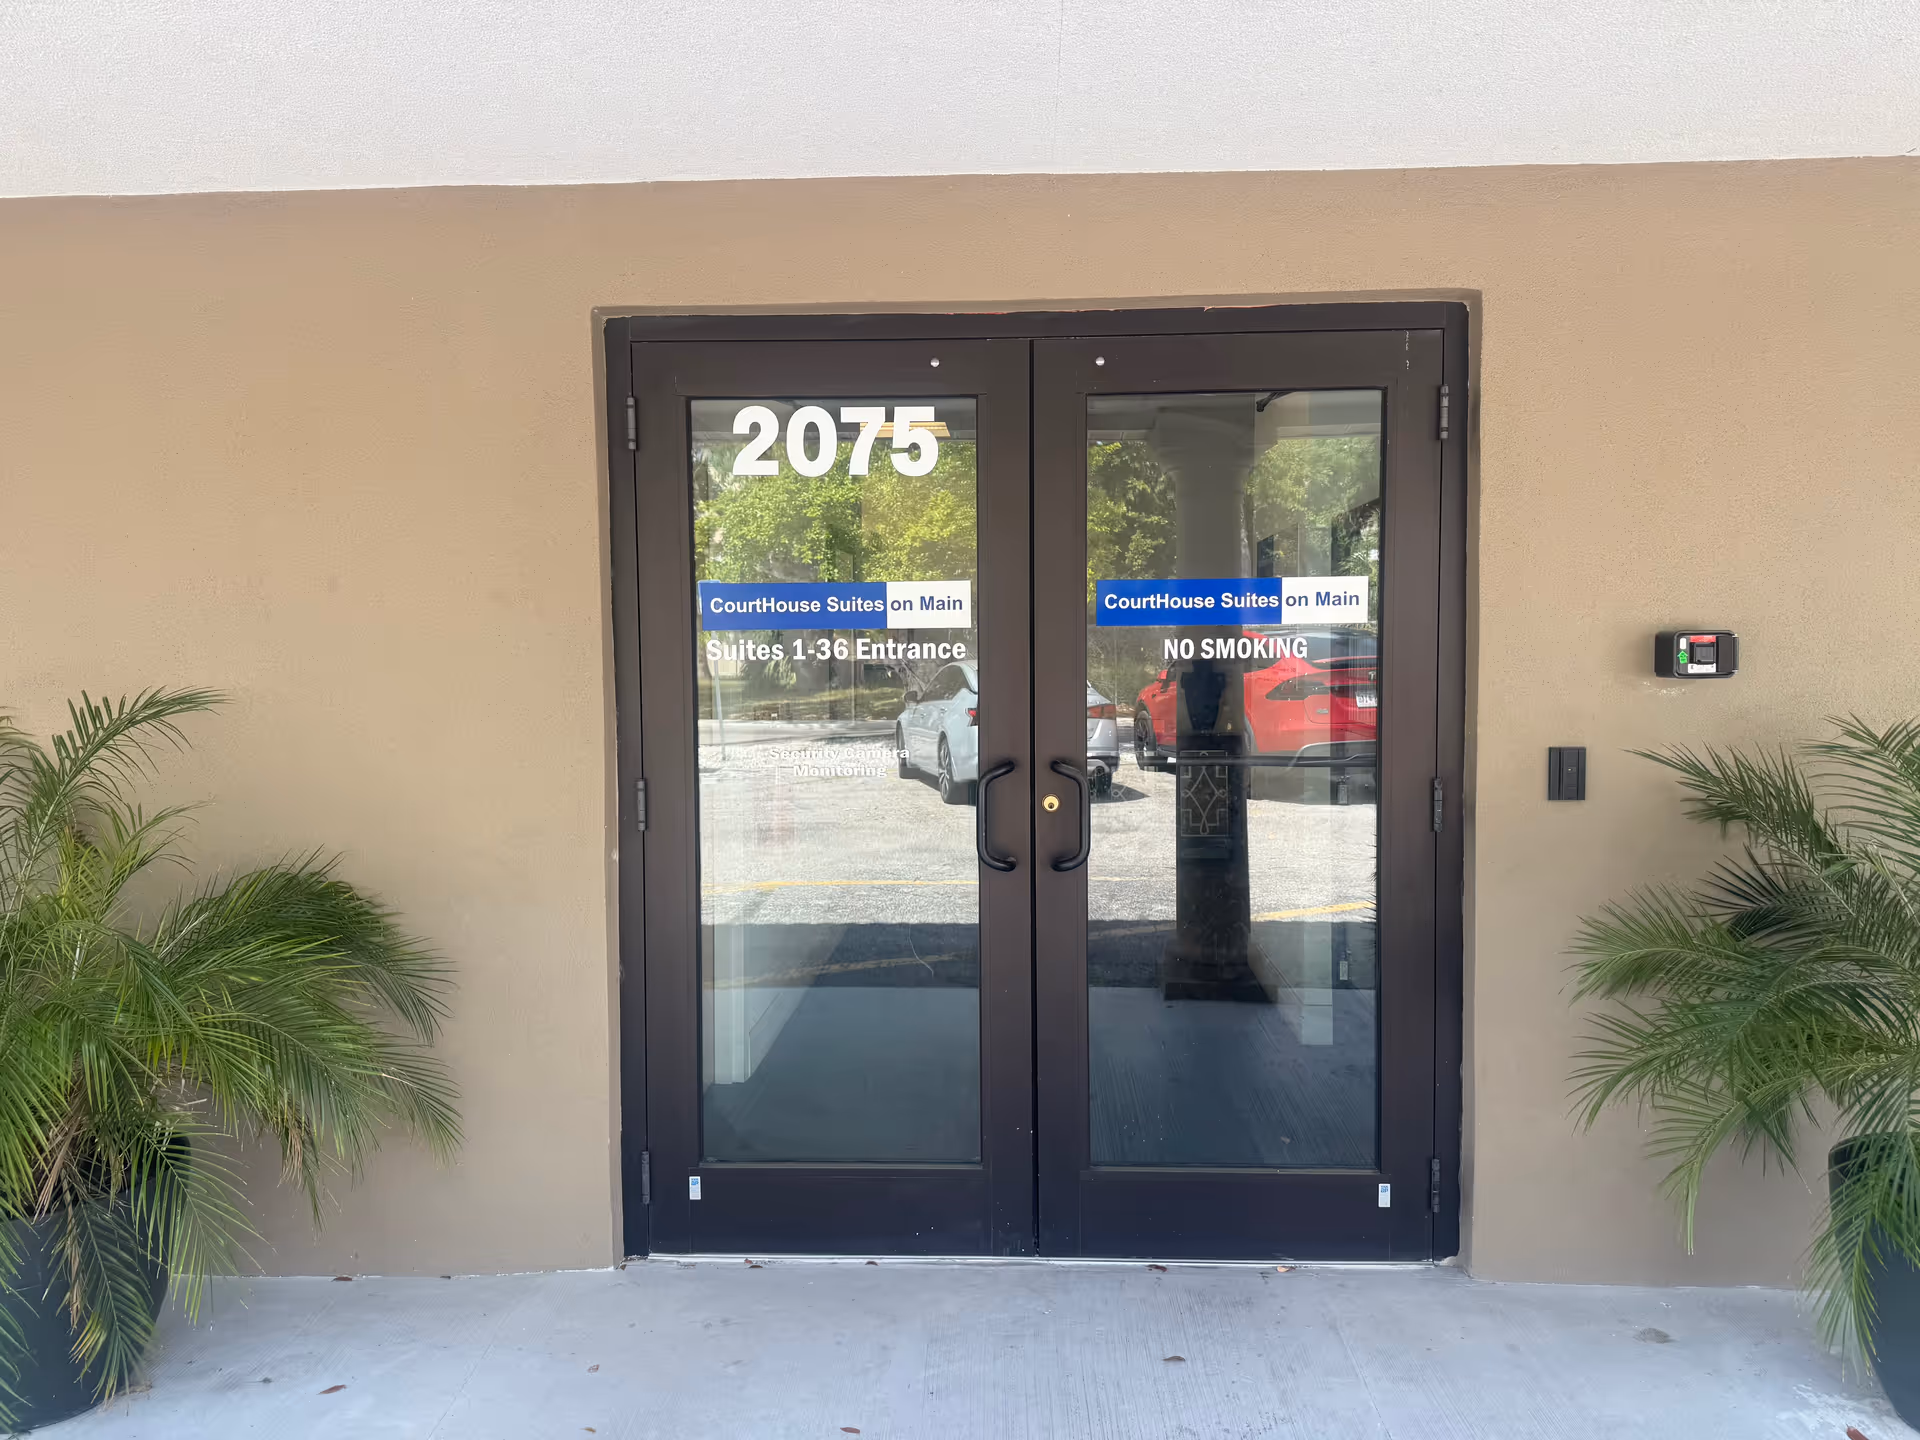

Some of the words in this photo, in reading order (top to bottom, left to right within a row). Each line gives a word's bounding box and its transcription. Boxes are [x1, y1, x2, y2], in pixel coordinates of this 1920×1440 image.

[732, 405, 939, 477] 2075
[709, 597, 821, 614] CourtHouse
[826, 596, 885, 613] Suites
[890, 599, 913, 611] on
[919, 595, 963, 611] Main
[1104, 593, 1215, 610] CourtHouse
[1220, 592, 1279, 609] Suites
[1285, 595, 1308, 607] on
[1315, 591, 1360, 607] Main
[706, 639, 784, 661] Suites
[792, 638, 849, 661] 1-36
[856, 638, 967, 660] Entrance
[1163, 638, 1195, 660] NO
[1200, 637, 1309, 660] SMOKING
[769, 747, 840, 761] Security
[844, 747, 910, 760] Camera
[793, 764, 888, 778] Monitoring
